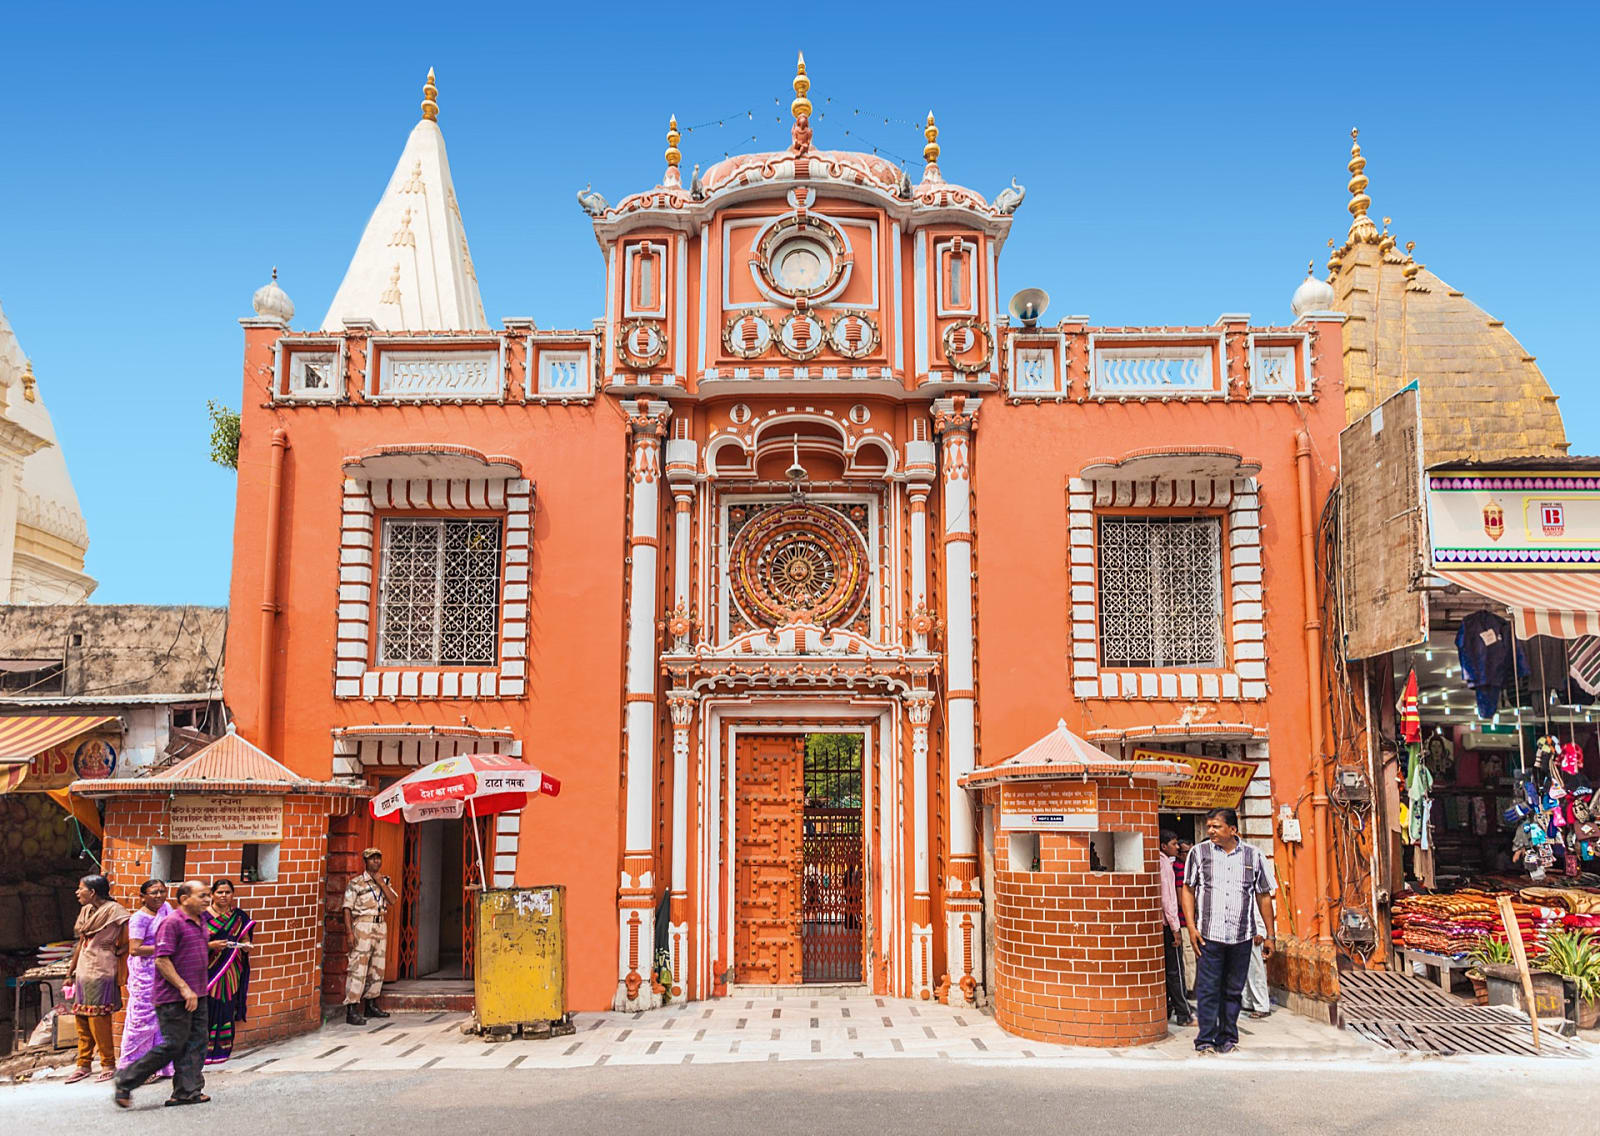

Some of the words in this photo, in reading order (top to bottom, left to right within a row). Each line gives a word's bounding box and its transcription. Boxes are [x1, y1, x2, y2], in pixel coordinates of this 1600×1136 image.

[1197, 762, 1248, 778] ROOM
[484, 779, 503, 787] टाटा
[505, 779, 525, 787] नमक
[420, 788, 434, 798] देश
[435, 787, 446, 796] का
[447, 784, 464, 794] नमक
[211, 798, 242, 806] सूचना
